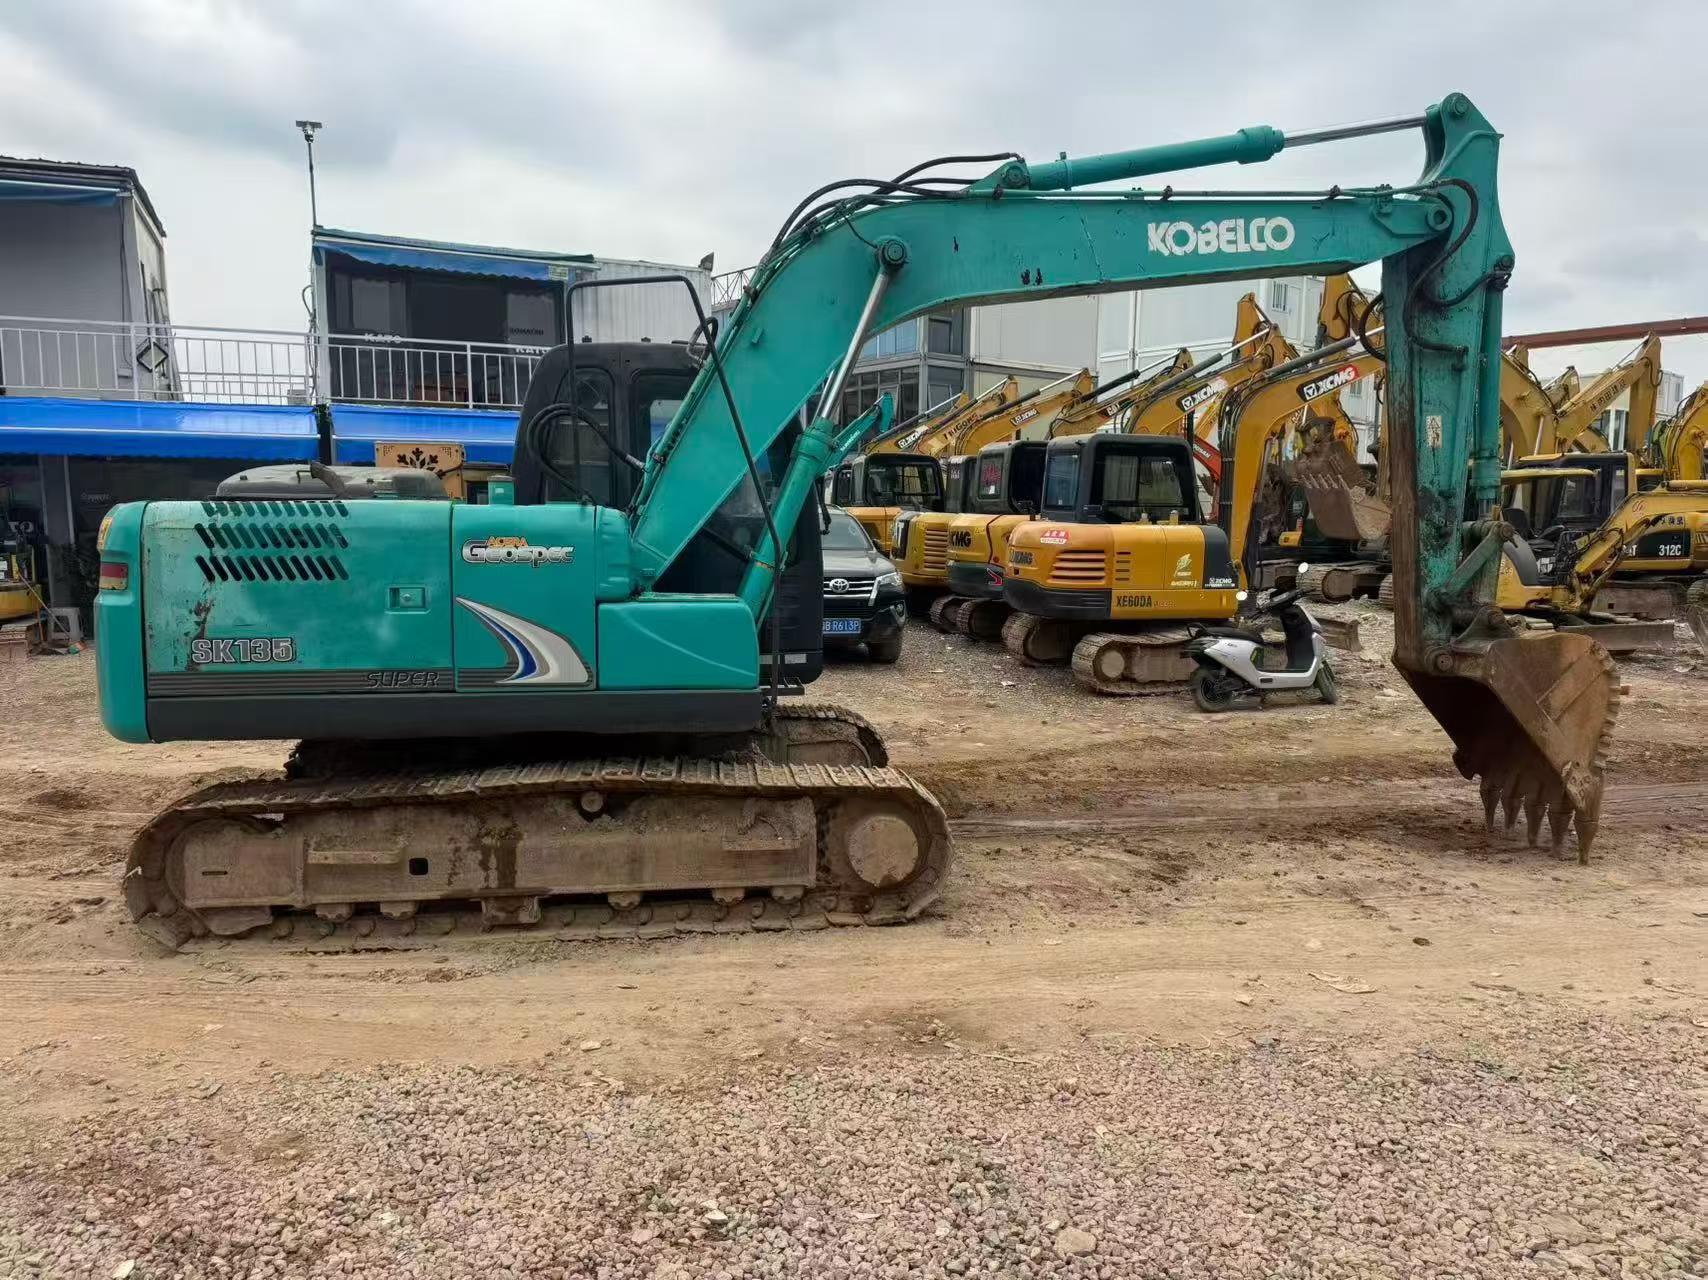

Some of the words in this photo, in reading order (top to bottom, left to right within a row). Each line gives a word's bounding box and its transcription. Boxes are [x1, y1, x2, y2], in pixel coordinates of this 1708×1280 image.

[1148, 217, 1295, 256] KOBELCO
[1317, 366, 1356, 394] XCMG
[462, 539, 575, 568] Geospec
[1658, 544, 1682, 556] 312C
[1116, 595, 1152, 608] XE60DA
[192, 638, 294, 664] SK135
[366, 670, 440, 689] SUPER
